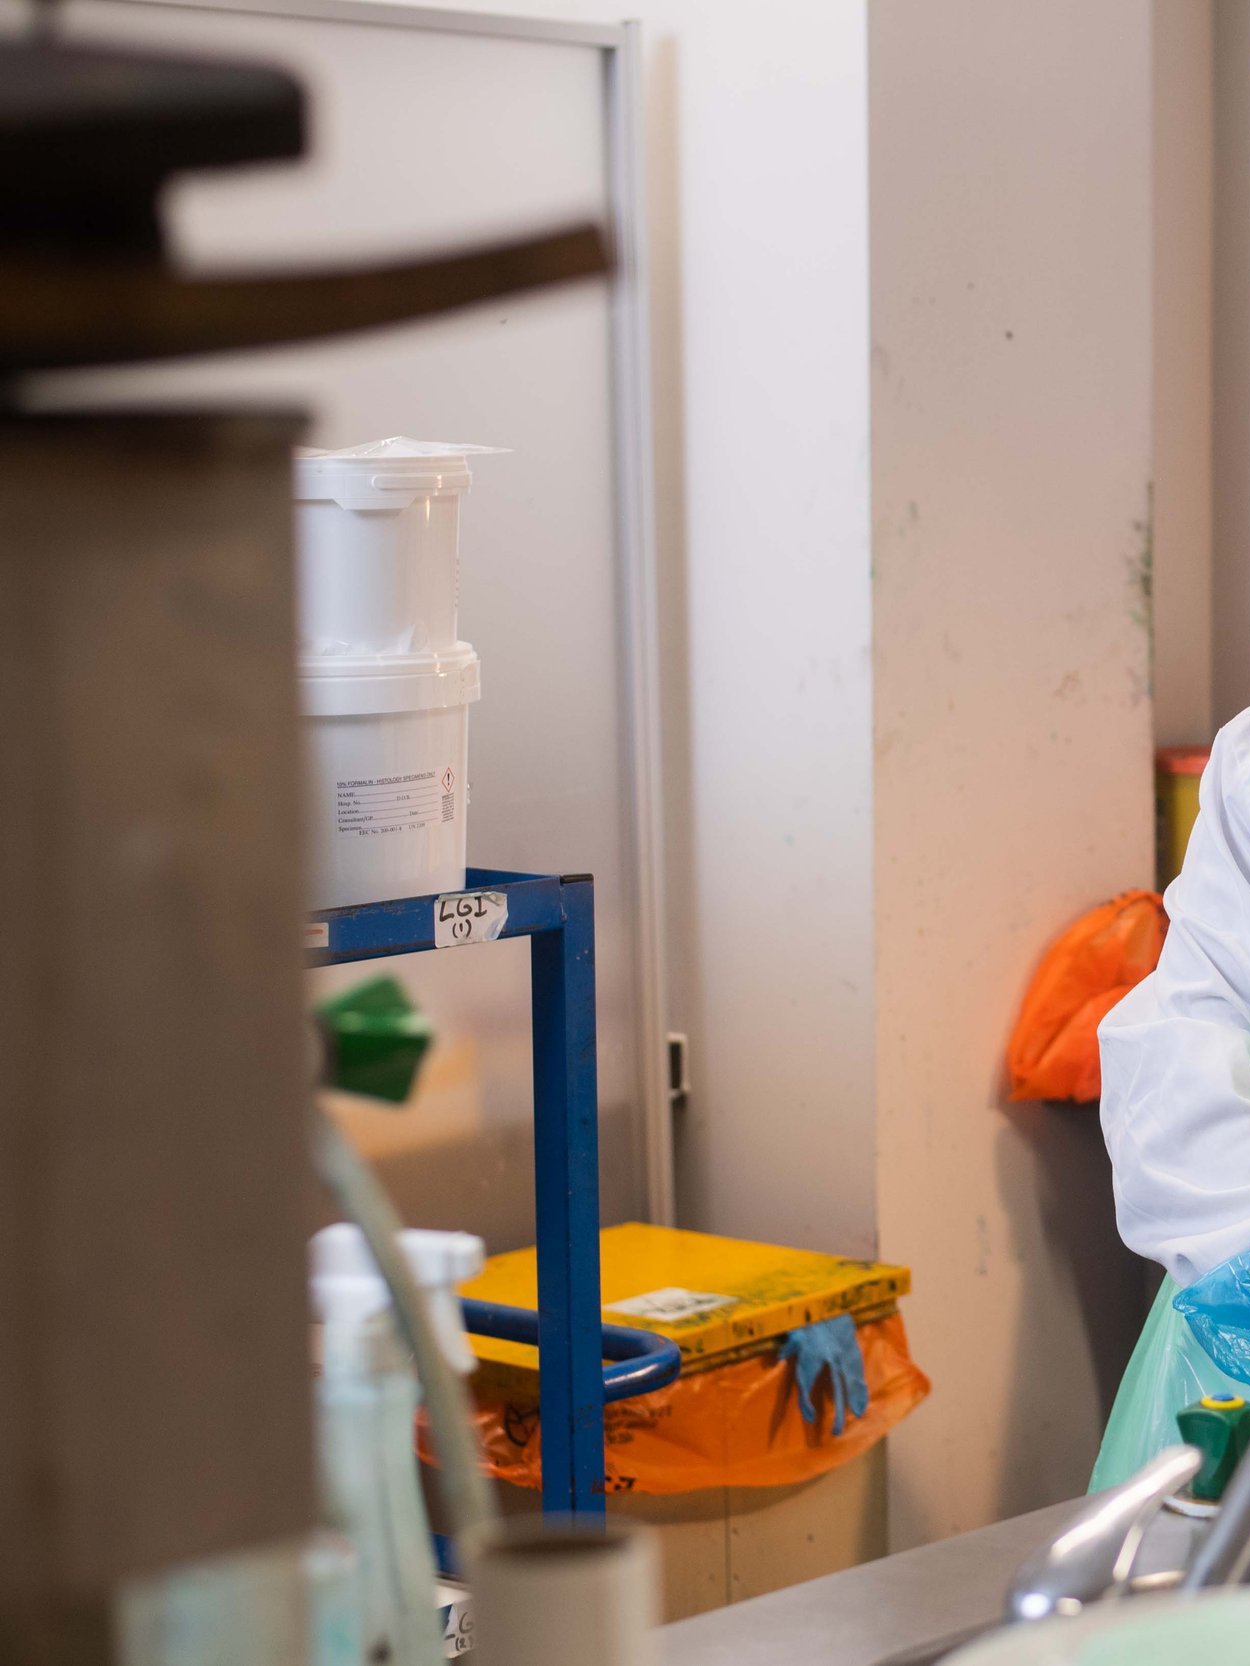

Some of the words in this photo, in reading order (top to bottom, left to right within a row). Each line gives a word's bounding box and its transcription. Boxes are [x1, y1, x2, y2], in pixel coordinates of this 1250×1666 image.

[348, 778, 374, 787] FORMALIN
[377, 776, 402, 785] HISTOLOGY
[439, 897, 488, 922] LGI
